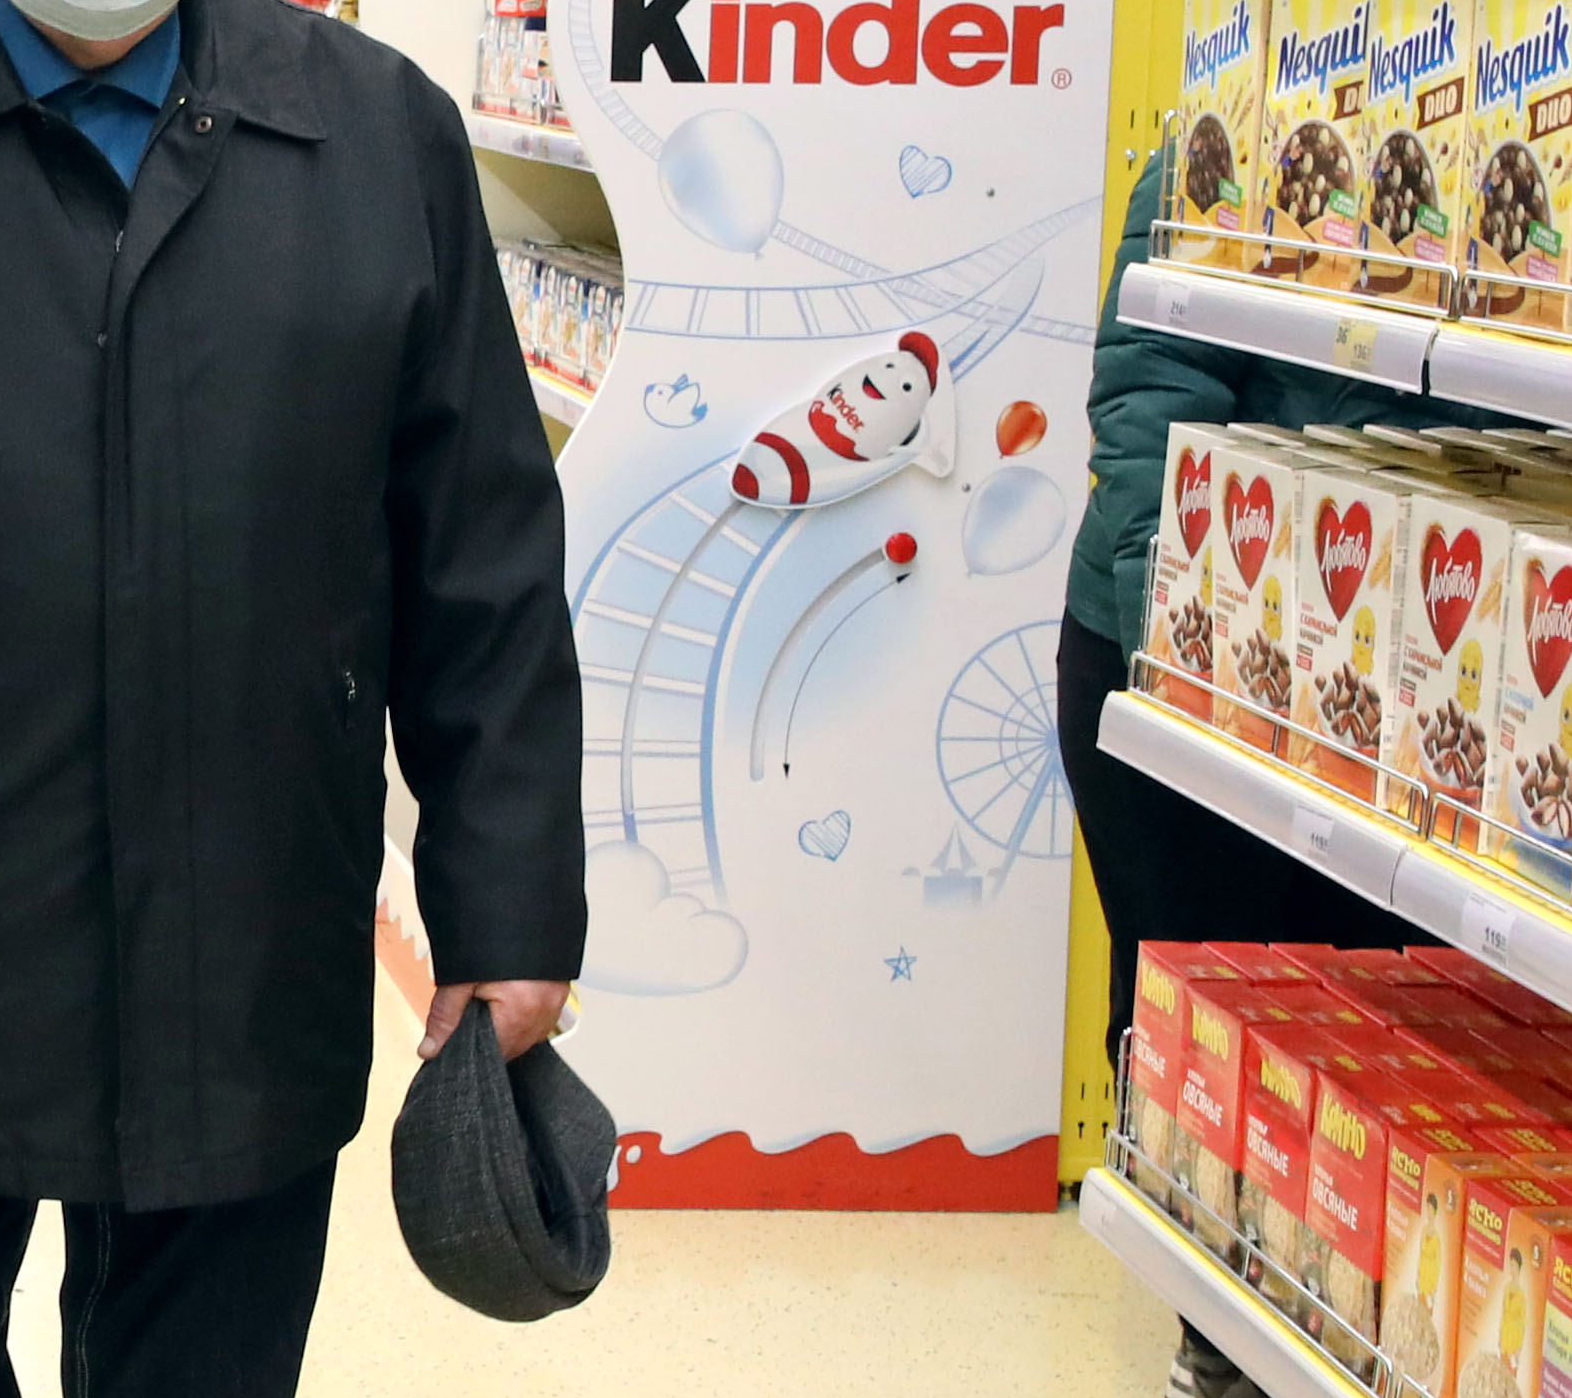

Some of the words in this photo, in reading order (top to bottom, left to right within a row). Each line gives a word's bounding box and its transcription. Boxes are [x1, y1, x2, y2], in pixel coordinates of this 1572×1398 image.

[1184, 0, 1250, 88] Nesquik
[1276, 2, 1366, 93] Nesqui
[1368, 2, 1454, 103] Nesquik
[1474, 6, 1570, 110] Nesquik
[1424, 86, 1457, 119] DUO
[1537, 92, 1572, 130] DUO
[1230, 503, 1270, 564] Любятово
[1321, 529, 1366, 590] Любятово
[1426, 558, 1475, 623] Любятово
[1183, 1080, 1223, 1128] ОВСЯНЫЕ
[1312, 1175, 1359, 1232] ОВСЯНЫЕ
